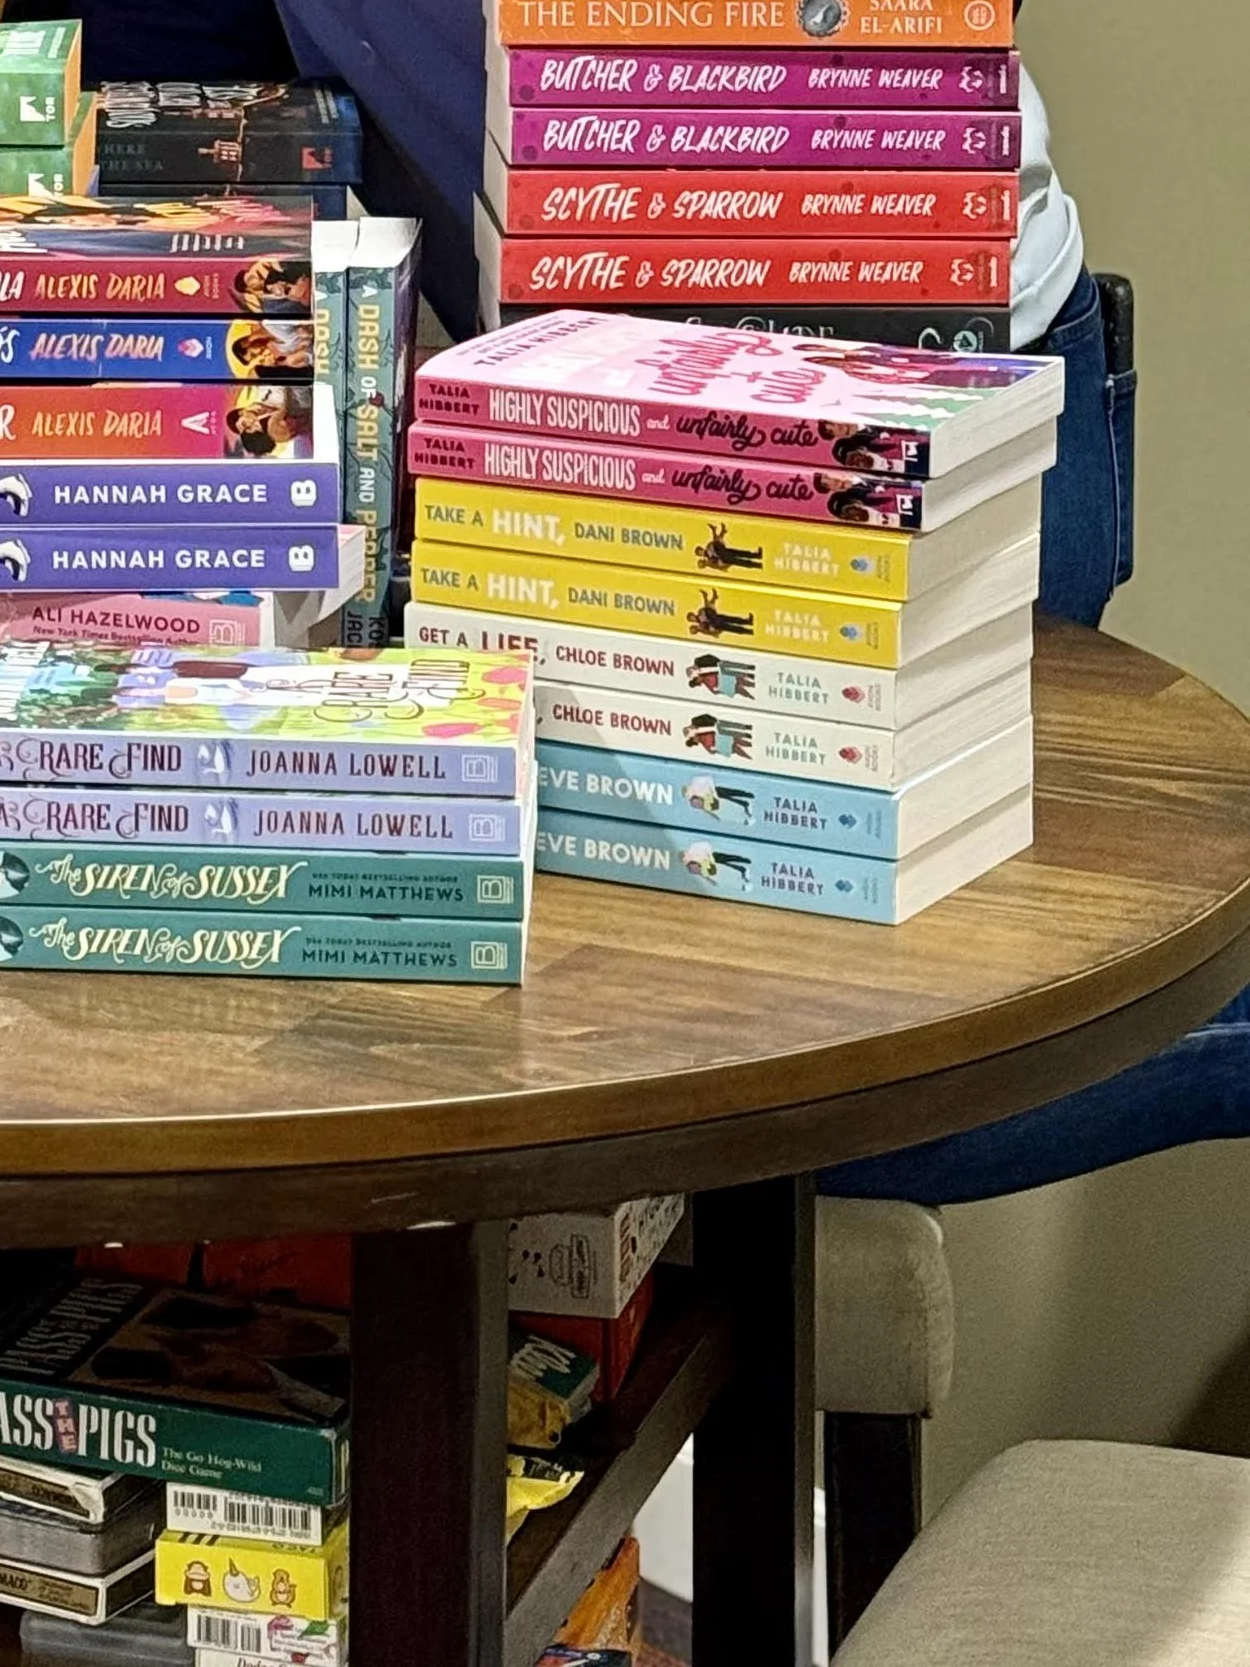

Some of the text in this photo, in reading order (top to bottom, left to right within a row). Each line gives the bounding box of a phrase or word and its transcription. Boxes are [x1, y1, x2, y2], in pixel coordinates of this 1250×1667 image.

[520, 0, 784, 27] THE ENDING FIRE
[860, 16, 942, 34] EL-ARIFI
[540, 54, 942, 93] BUTCHER BLACKBIRD BRYNNE WEAVER
[542, 182, 936, 222] SCYTHE SPARROW BRYNNE WEAVER
[35, 273, 98, 300] ALEXIS
[106, 273, 164, 302] DARIA
[30, 334, 102, 361] ALEXIS
[105, 334, 164, 360] DARIA
[429, 384, 469, 399] TALIA
[32, 412, 95, 436] ALEXIS
[103, 410, 162, 436] DARIA
[419, 389, 819, 451] HIBBERT HIGHLY SUSPICIOUS unfairly cute
[357, 409, 379, 462] SALT
[55, 485, 166, 504] HANNAH
[177, 484, 267, 503] GRACE
[424, 505, 683, 550] TAKE HINT, DANI BROWN
[32, 608, 64, 623] ALI
[71, 609, 201, 634] HAZELWOOD
[419, 626, 675, 677] GET CHLOE BROWN
[777, 671, 822, 689] TALIA
[768, 684, 829, 705] HIBBERT
[245, 749, 446, 780] JOANNA LOWELL
[587, 774, 672, 806] BROWN
[773, 796, 819, 813] TALIA
[763, 810, 827, 831] HIBBERT
[190, 861, 309, 904] SUSSEX
[309, 883, 353, 898] MIMI
[360, 884, 464, 902] MATTHEWS
[78, 1404, 157, 1467] PIGS
[161, 1461, 223, 1479] Dice Game
[162, 1447, 262, 1472] The Go Hog-Wild
